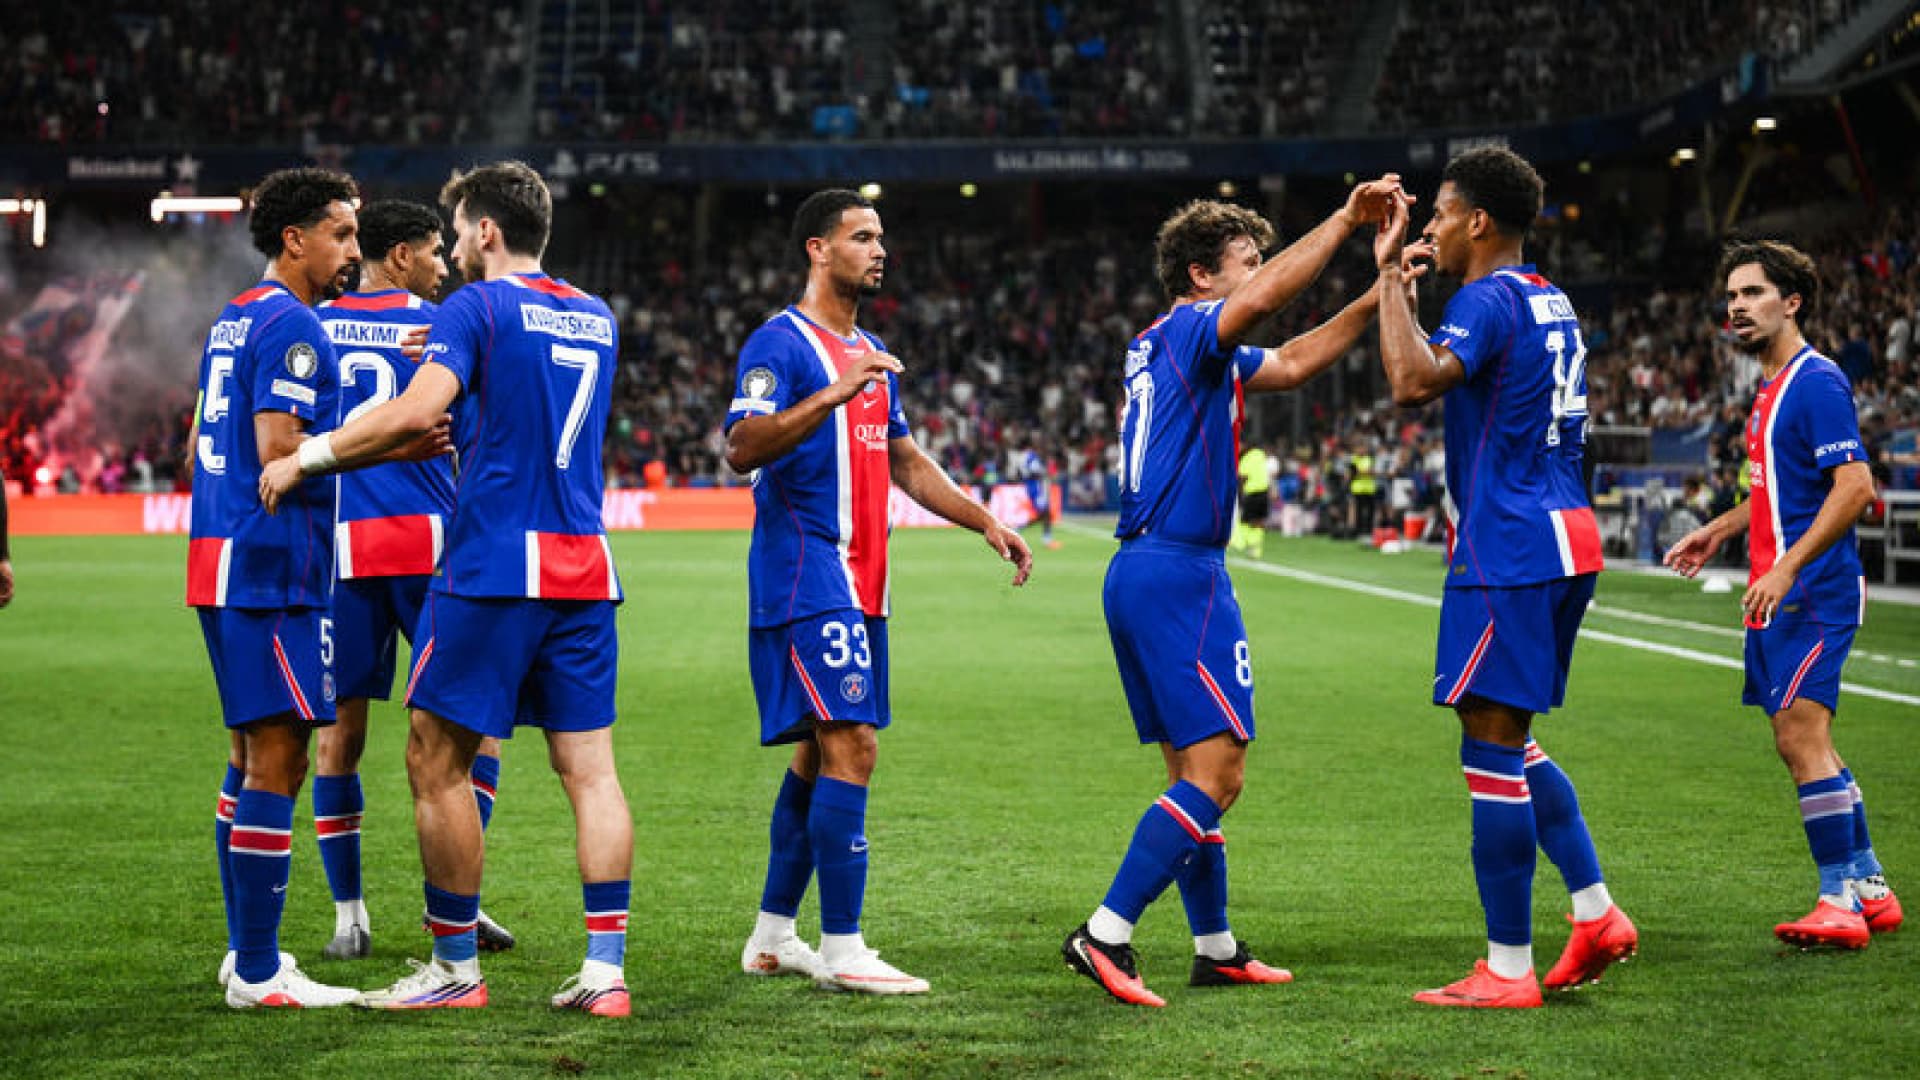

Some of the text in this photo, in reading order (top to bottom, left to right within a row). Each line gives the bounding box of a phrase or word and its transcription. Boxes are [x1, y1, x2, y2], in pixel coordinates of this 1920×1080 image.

[334, 323, 399, 343] HAKIMI
[340, 352, 397, 428] 2
[552, 343, 600, 469] 7
[198, 356, 234, 475] 5
[319, 617, 334, 667] 5
[822, 621, 872, 669] 33
[1234, 640, 1252, 687] 8
